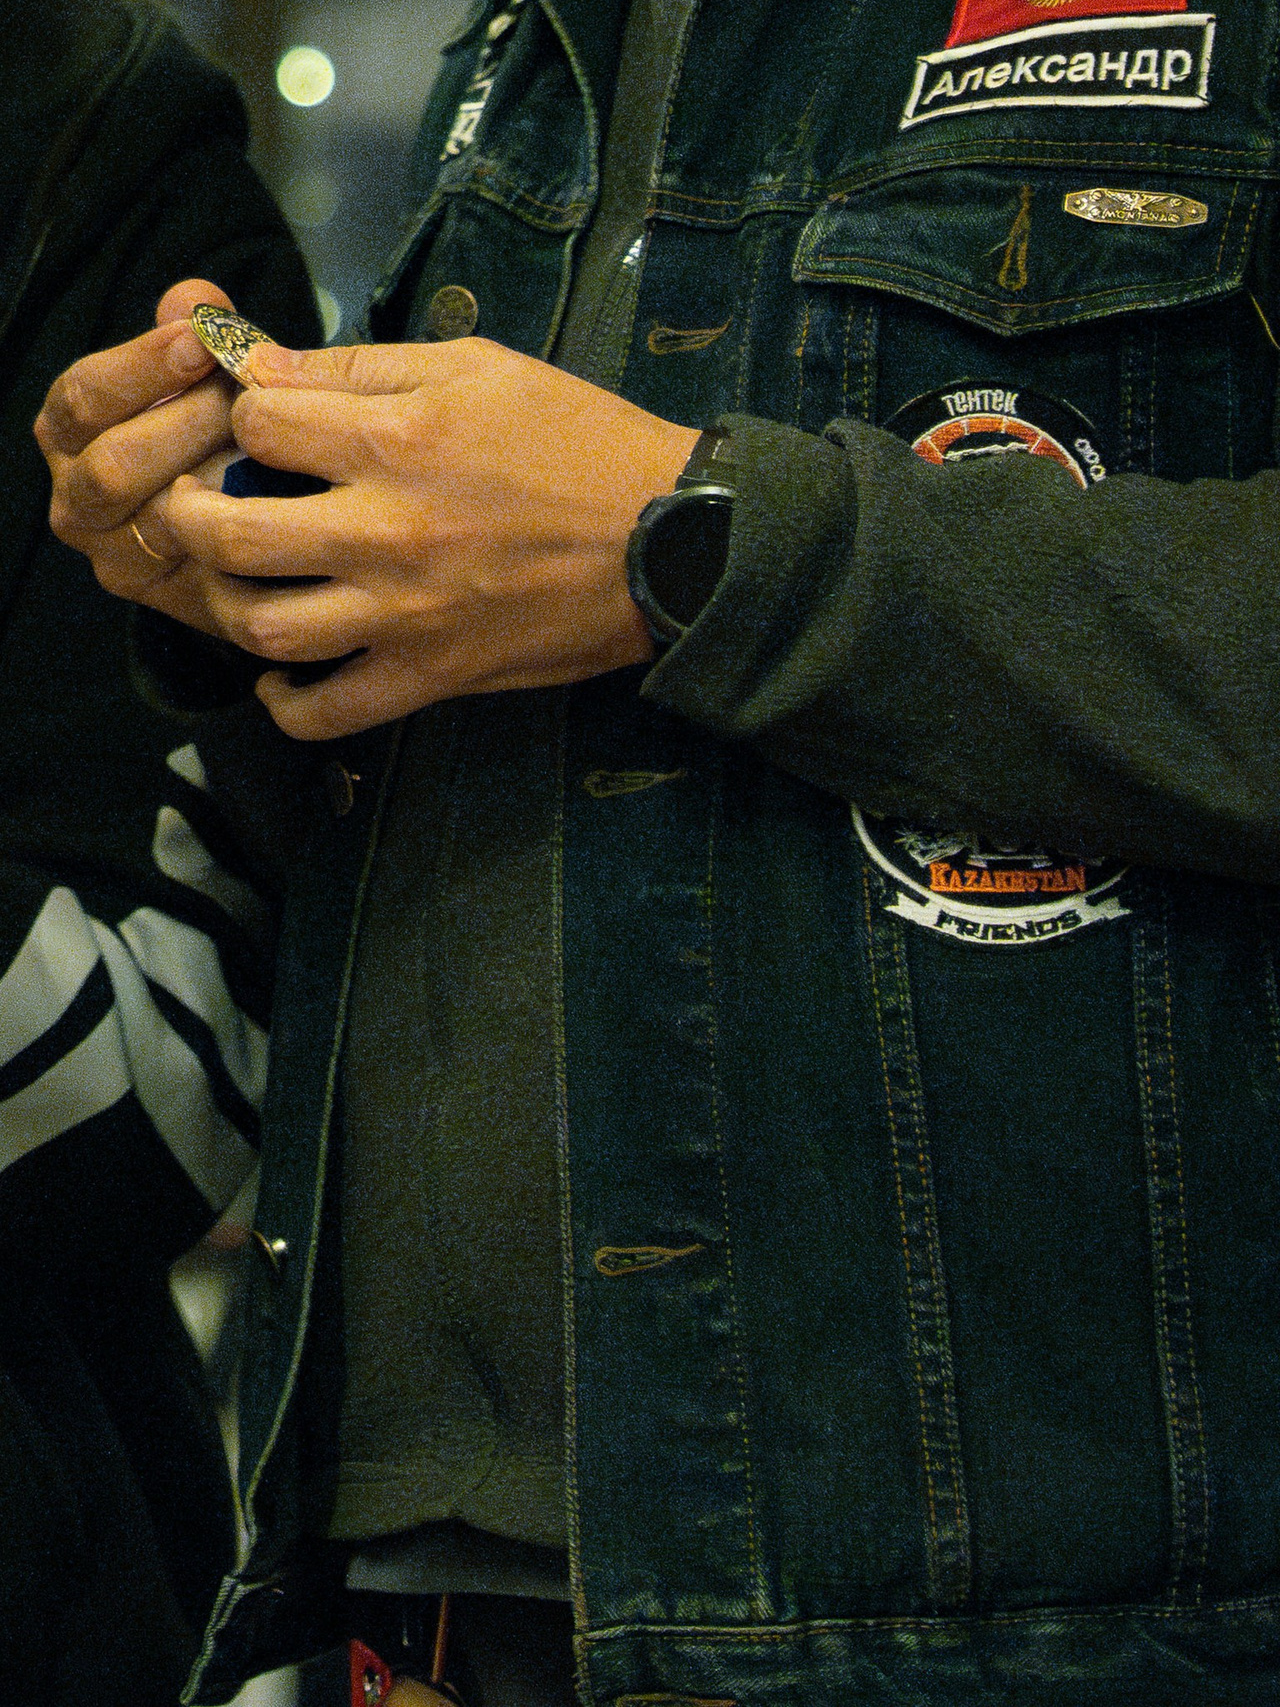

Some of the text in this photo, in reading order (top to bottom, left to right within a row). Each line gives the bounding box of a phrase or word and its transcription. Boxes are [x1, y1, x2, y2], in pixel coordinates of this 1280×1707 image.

[921, 48, 1192, 105] Александр
[929, 862, 1086, 892] KAZAKHSTAN
[934, 909, 1082, 940] FRIENDS
